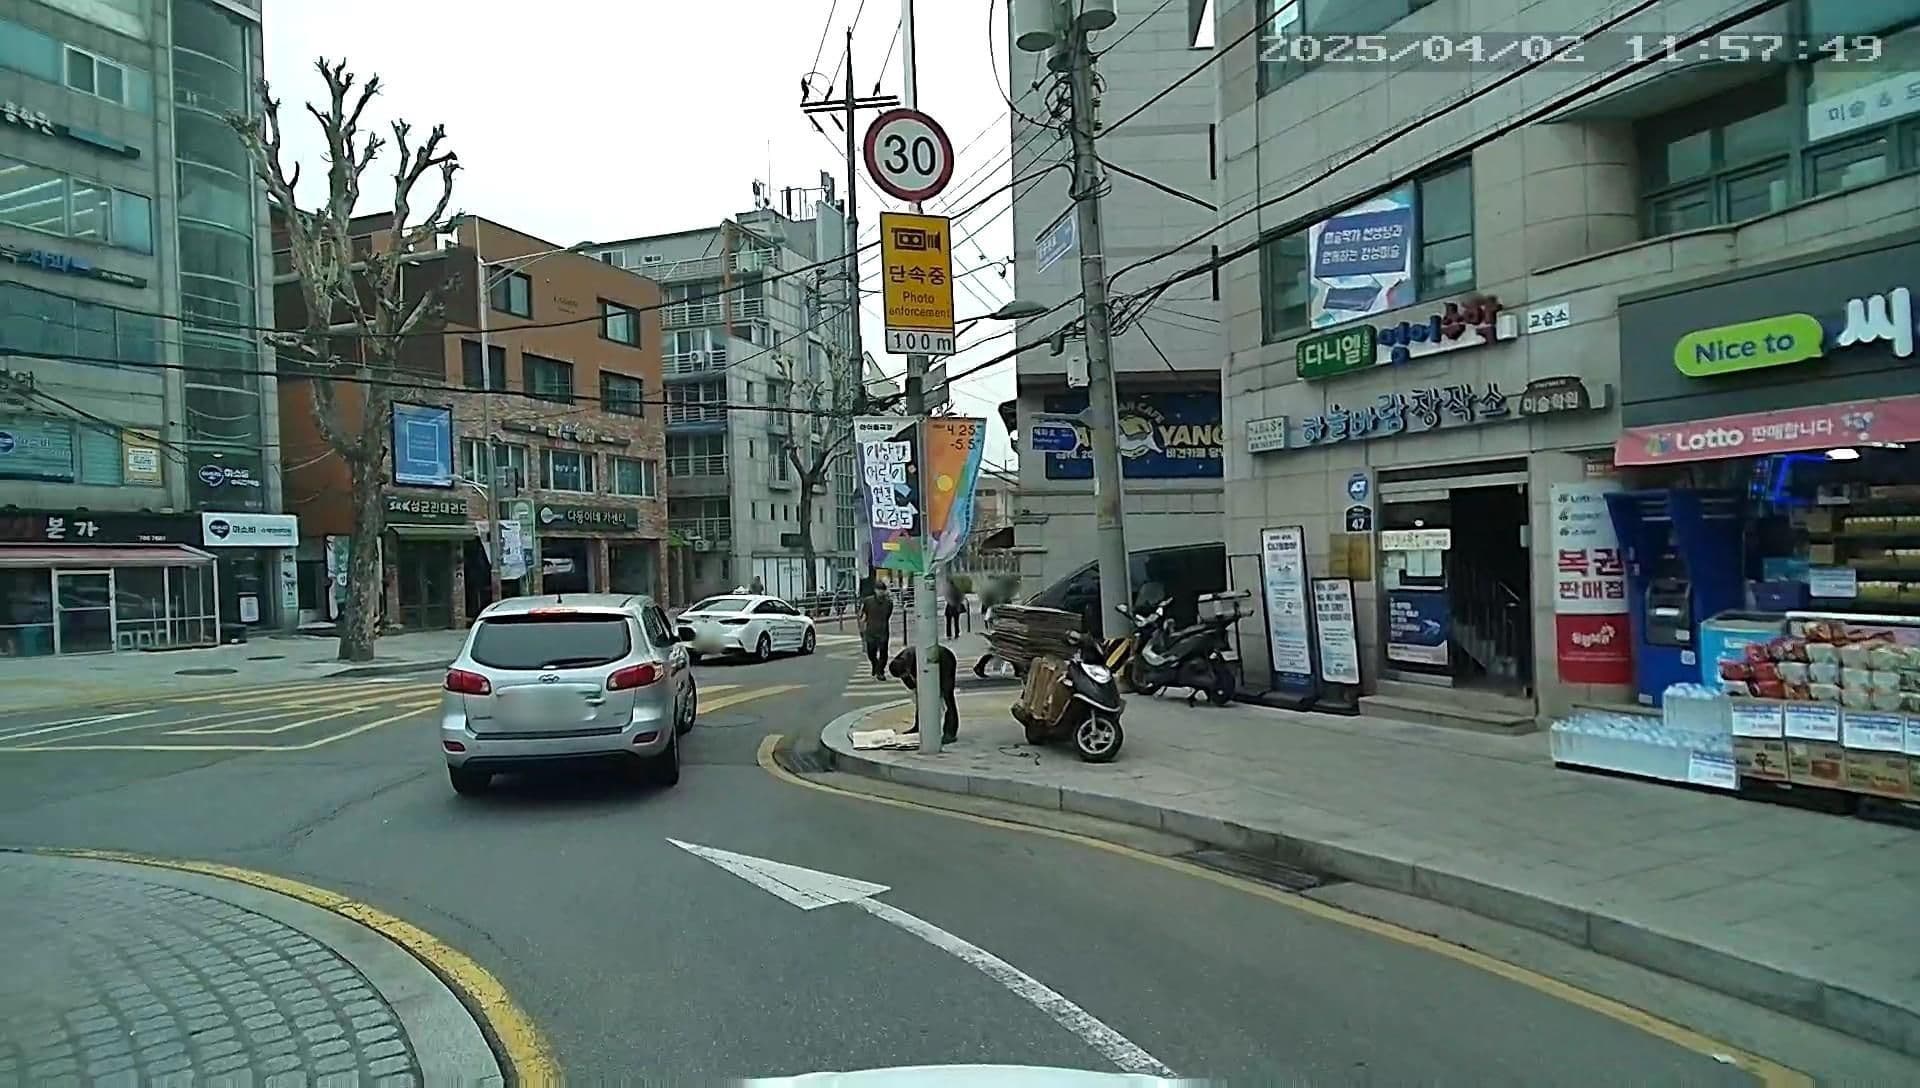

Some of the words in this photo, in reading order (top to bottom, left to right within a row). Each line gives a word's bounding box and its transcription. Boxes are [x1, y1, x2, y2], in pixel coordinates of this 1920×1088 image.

[884, 134, 936, 176] 30
[889, 265, 946, 285] 단속중
[903, 291, 935, 304] Photo
[888, 305, 950, 319] enforcement
[1528, 309, 1569, 328] 교습소
[893, 333, 930, 350] 100
[937, 336, 951, 350] m
[1305, 335, 1362, 366] 다니엘
[1695, 339, 1756, 364] Nice
[1766, 332, 1795, 354] to
[1522, 391, 1578, 413] 미술학원
[1675, 427, 1744, 450] Lotto
[1752, 419, 1834, 442] 판매합니다
[865, 465, 905, 484] 어린이
[1352, 518, 1365, 530] 47
[1558, 548, 1625, 577] 복권
[1558, 580, 1625, 600] 판매점
